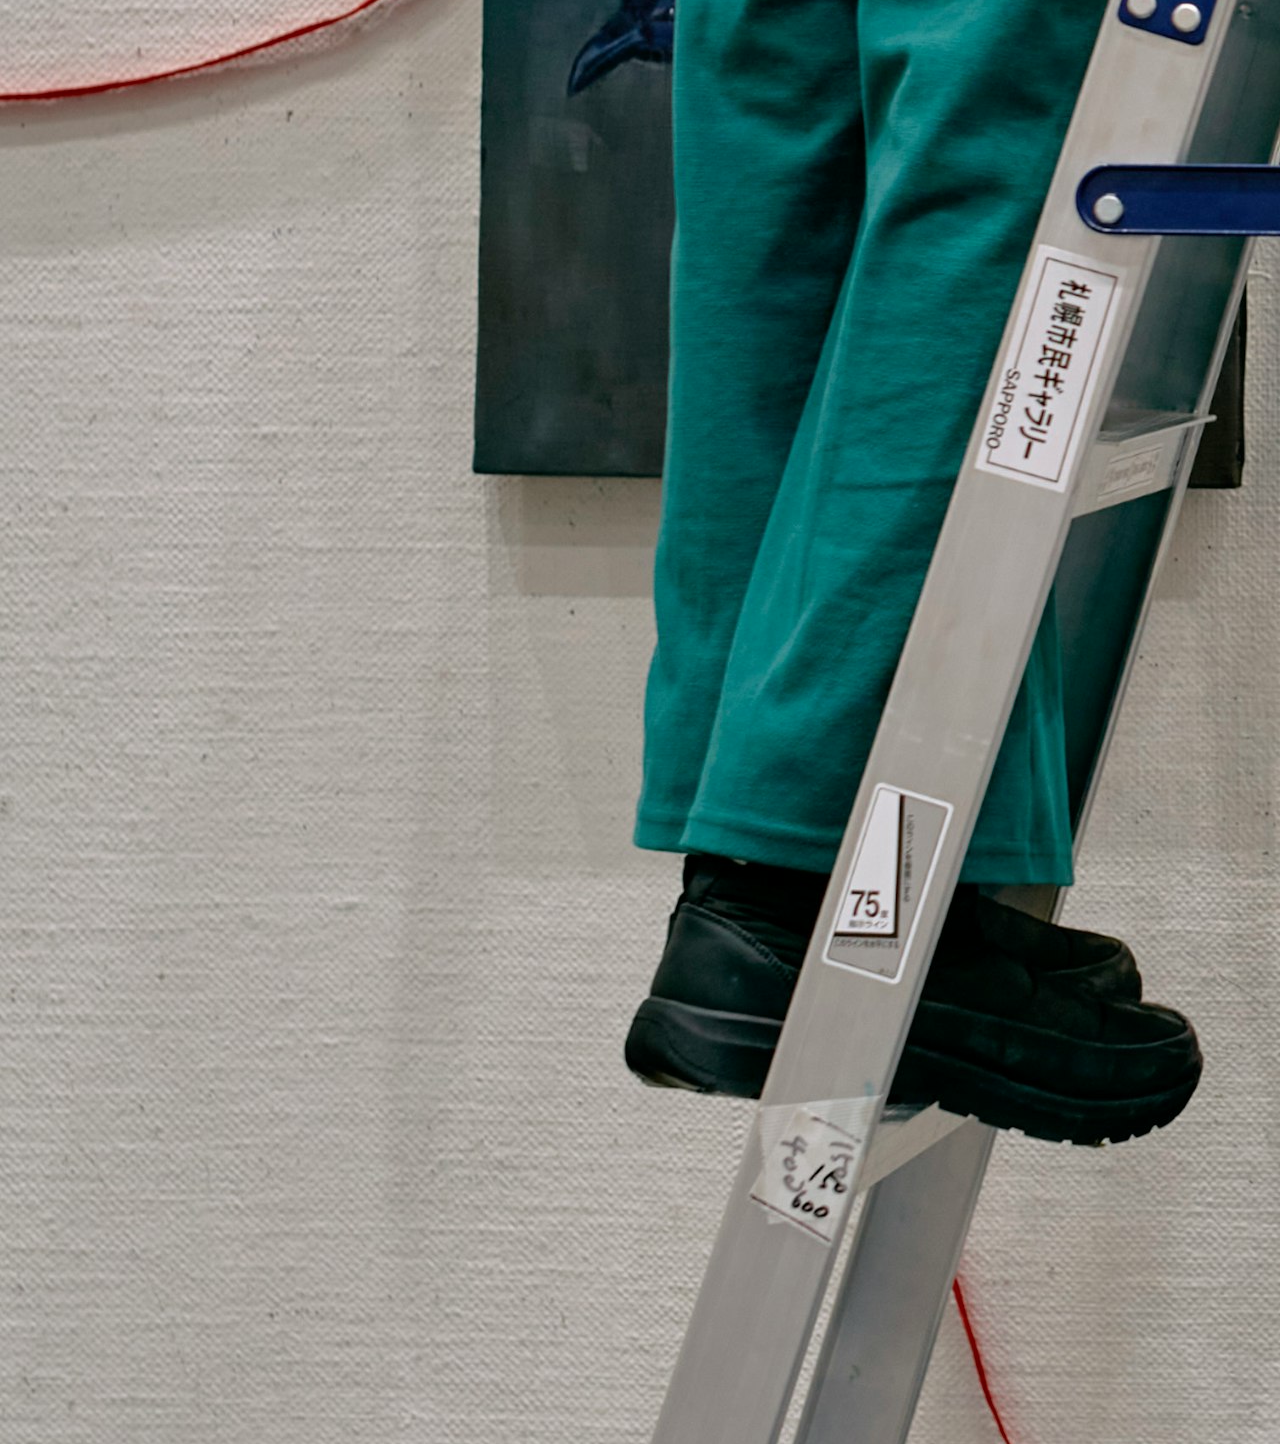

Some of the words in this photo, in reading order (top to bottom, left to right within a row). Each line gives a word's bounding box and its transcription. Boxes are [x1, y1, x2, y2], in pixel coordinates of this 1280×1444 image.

[986, 367, 1021, 450] SAPPORO
[1018, 279, 1093, 460] 札幌市民ギャラリー
[791, 1190, 830, 1218] 600
